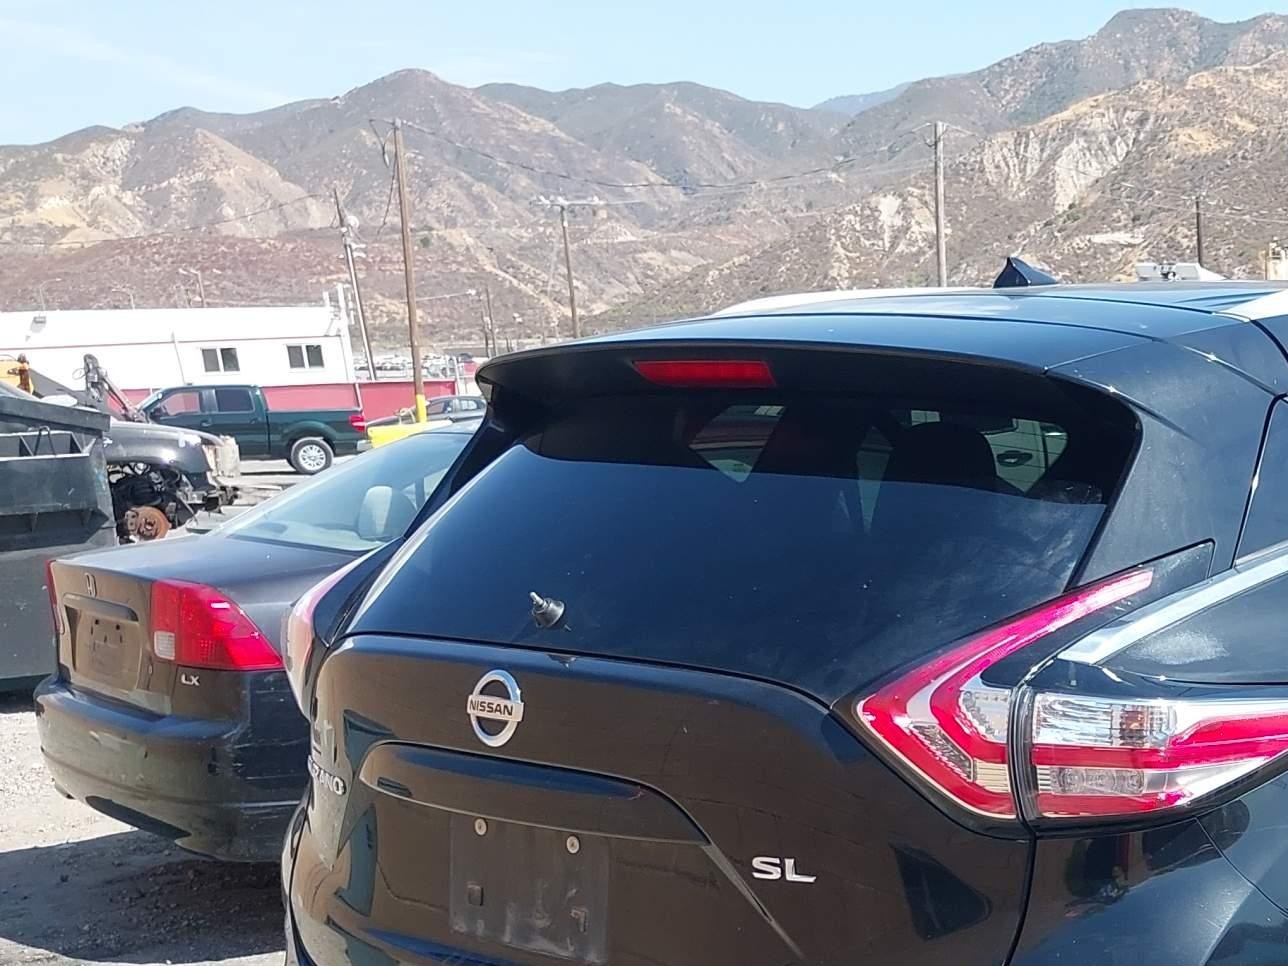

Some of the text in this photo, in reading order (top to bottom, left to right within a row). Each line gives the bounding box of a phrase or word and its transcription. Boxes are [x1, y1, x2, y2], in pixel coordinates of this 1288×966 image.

[181, 673, 200, 686] LX
[469, 699, 514, 716] NISSAN
[752, 856, 817, 883] SL
